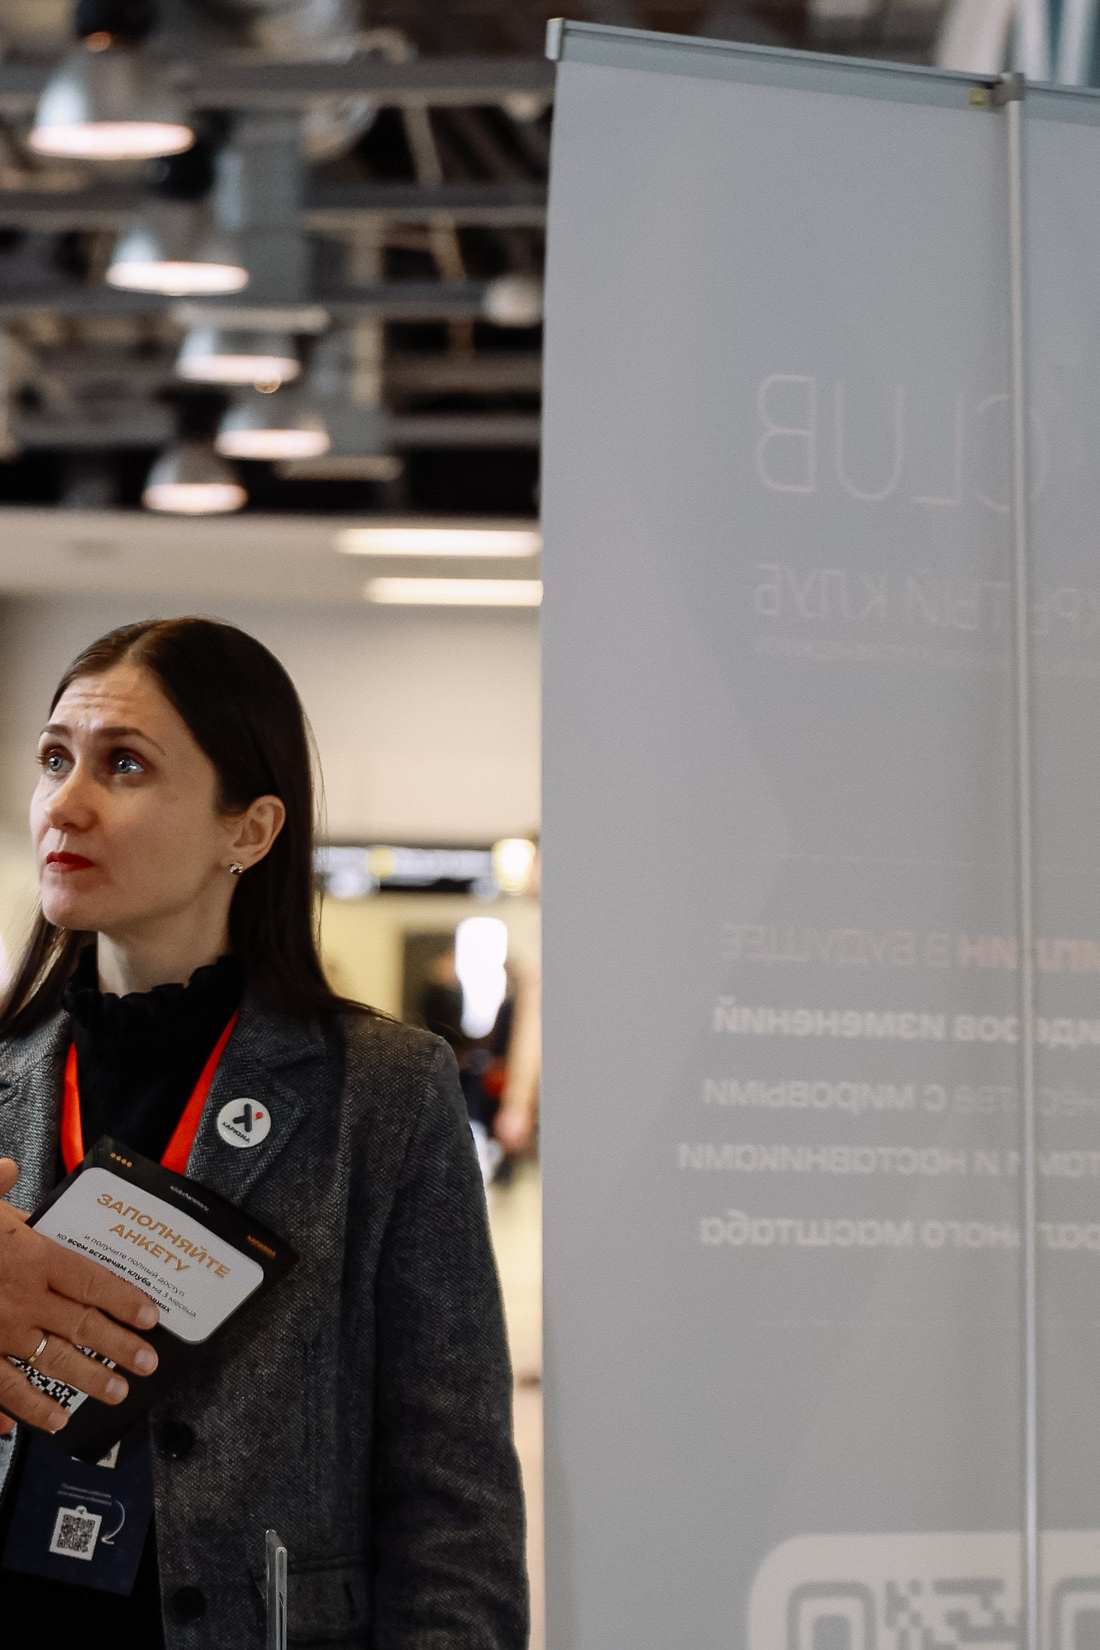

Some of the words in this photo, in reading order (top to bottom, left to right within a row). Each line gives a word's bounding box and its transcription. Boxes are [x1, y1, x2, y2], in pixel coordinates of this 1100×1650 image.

[91, 1237, 127, 1260] получите
[128, 1256, 159, 1279] полный
[158, 1276, 186, 1298] доступ
[96, 1192, 231, 1279] ЗАПОЛНЯЙТЕ
[109, 1223, 191, 1273] АНКЕТУ
[56, 1232, 67, 1241] ко
[67, 1237, 88, 1252] всем
[88, 1248, 127, 1272] встречам
[127, 1269, 152, 1288] клуба
[168, 1296, 197, 1318] месяца
